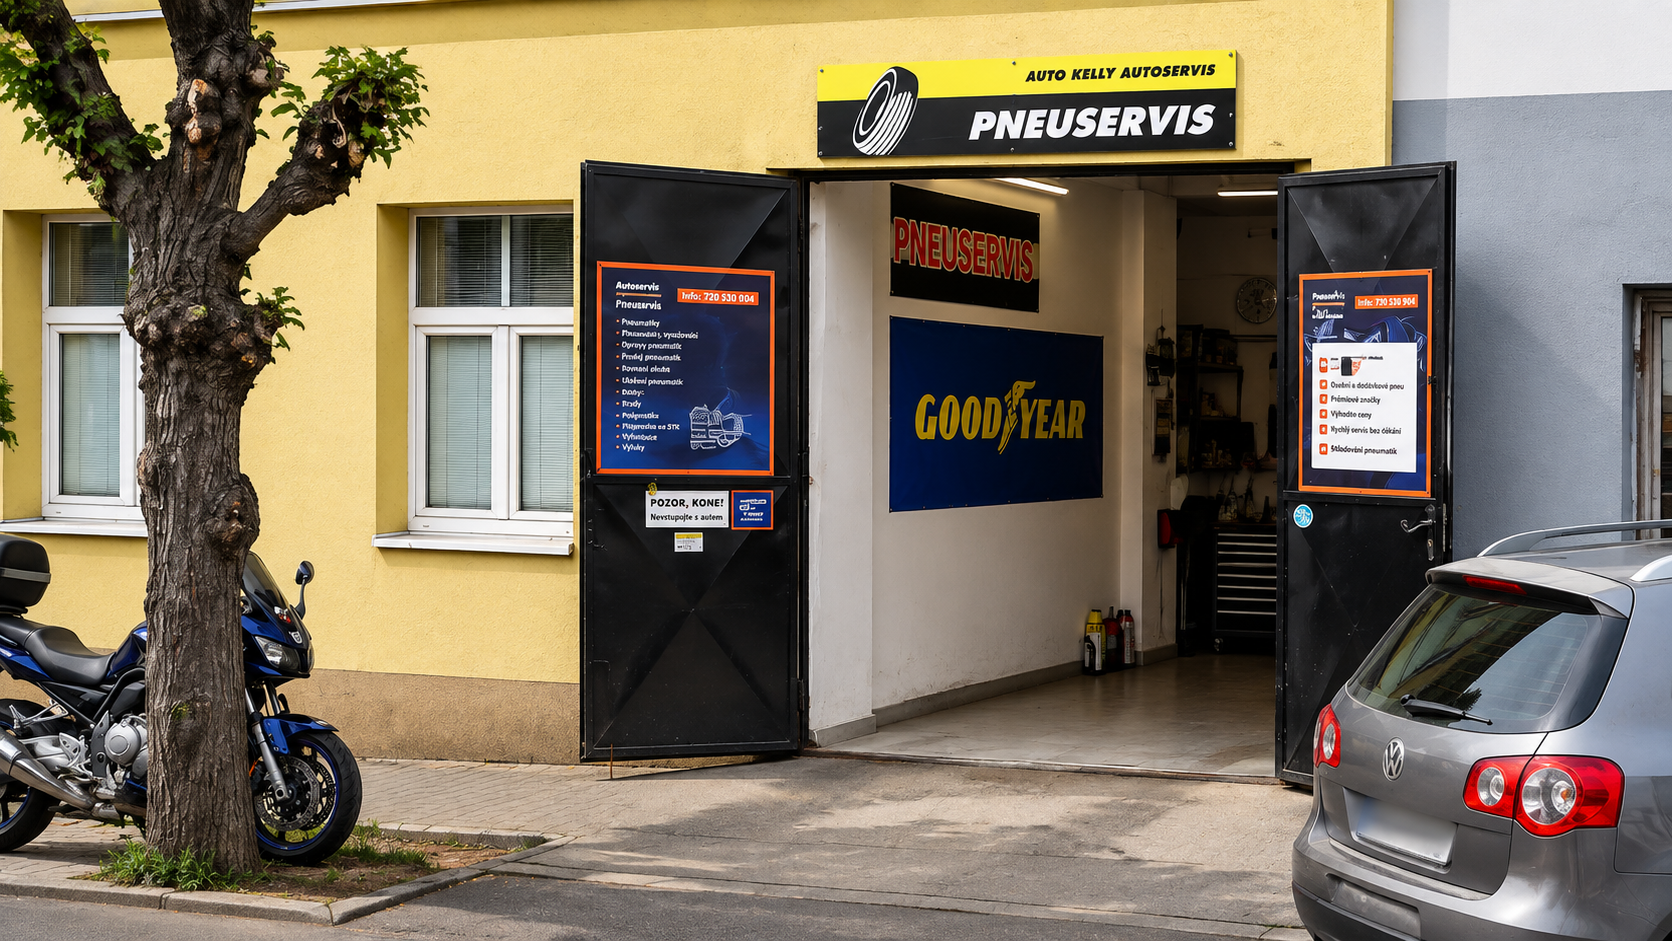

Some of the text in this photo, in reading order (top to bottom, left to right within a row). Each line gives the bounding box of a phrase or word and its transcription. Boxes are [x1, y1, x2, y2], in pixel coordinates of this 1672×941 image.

[1025, 64, 1216, 82] AUTO KELLY AUTOSERVIS
[968, 104, 1216, 140] PNEUSERVIS
[893, 216, 1034, 283] PNEUSERVIS
[615, 281, 660, 291] Autoservis
[703, 292, 720, 302] 720
[650, 499, 724, 509] POZOR, KONE!
[700, 513, 724, 521] autem
